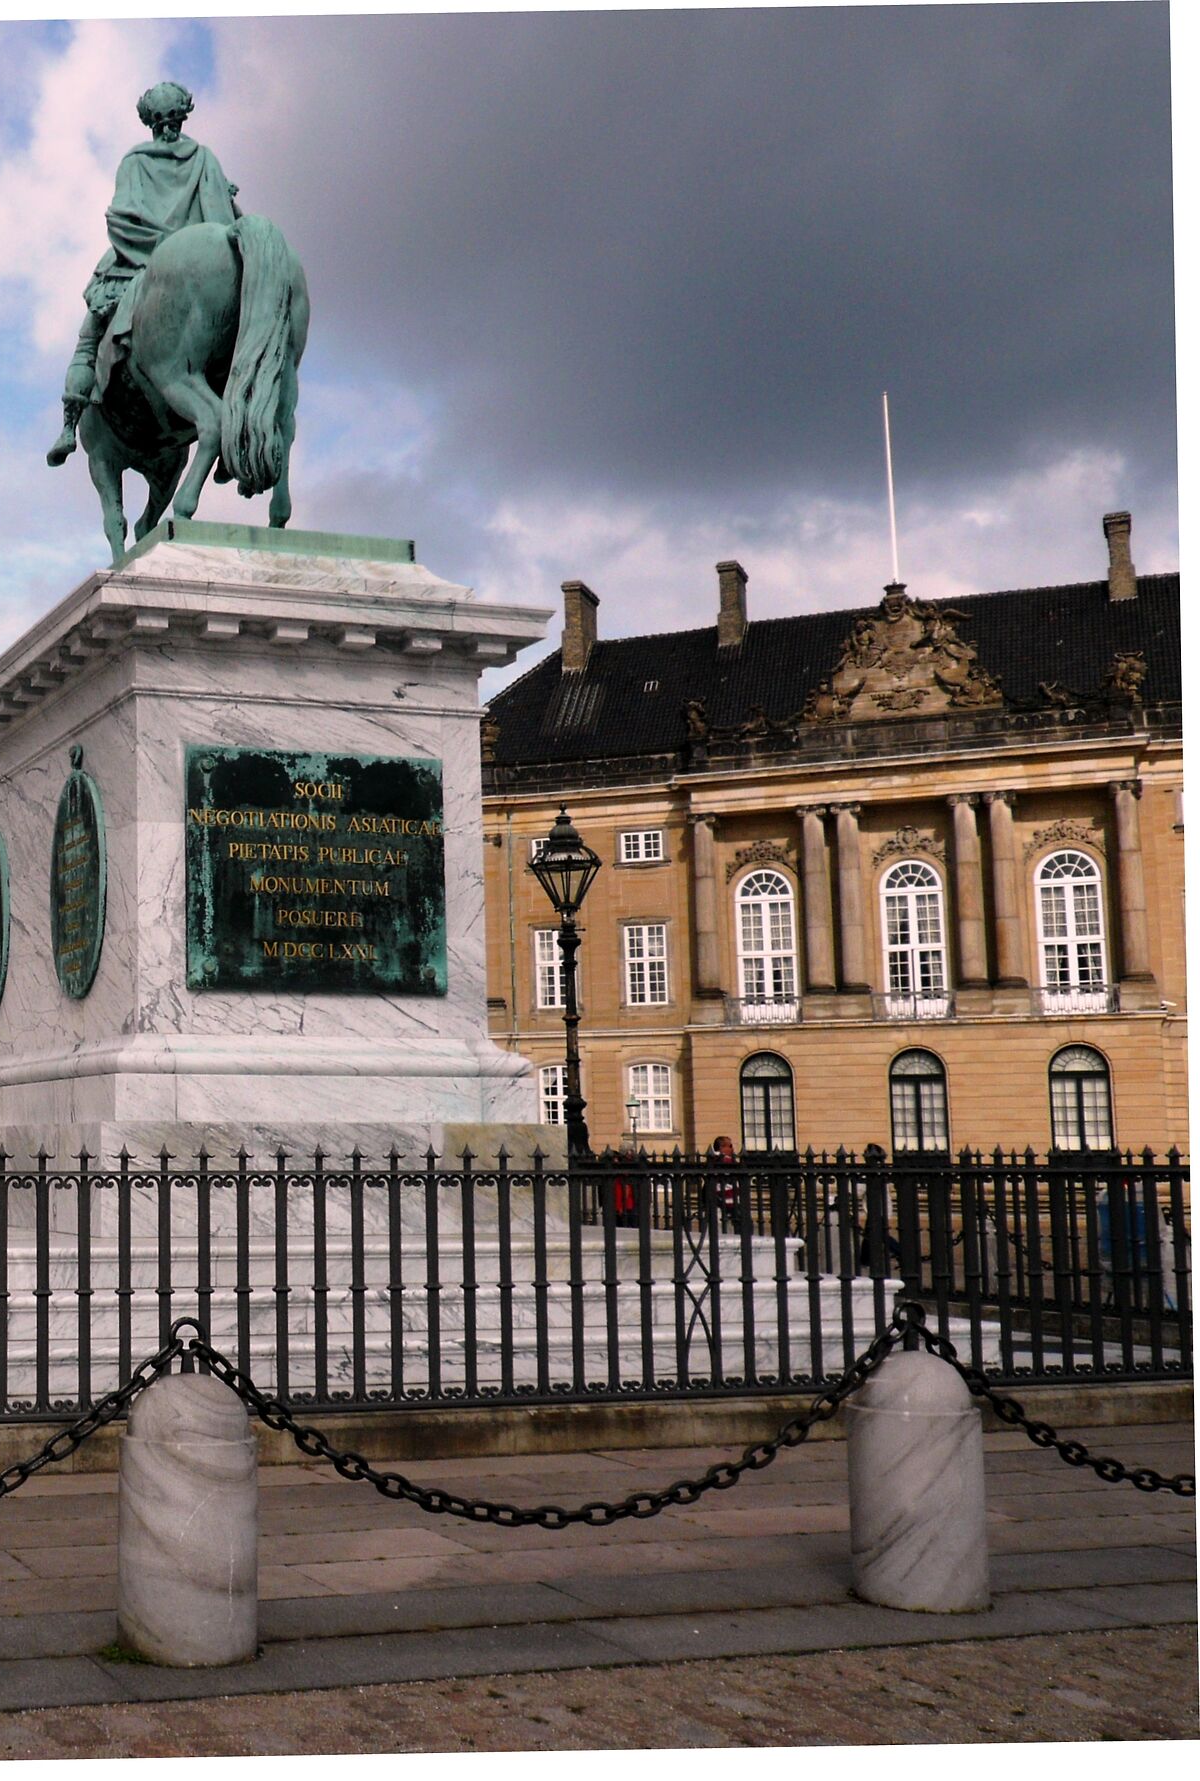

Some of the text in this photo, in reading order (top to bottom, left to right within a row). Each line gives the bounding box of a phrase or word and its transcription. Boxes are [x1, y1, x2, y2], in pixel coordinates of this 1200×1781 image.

[294, 781, 344, 800] SOCII
[190, 808, 443, 836] NEGOTIATIONIS ASIATICAE
[228, 842, 408, 866] PIETATIS PUBLICAE
[249, 876, 391, 897] MONUMENTUM
[277, 908, 365, 929] POSUERE
